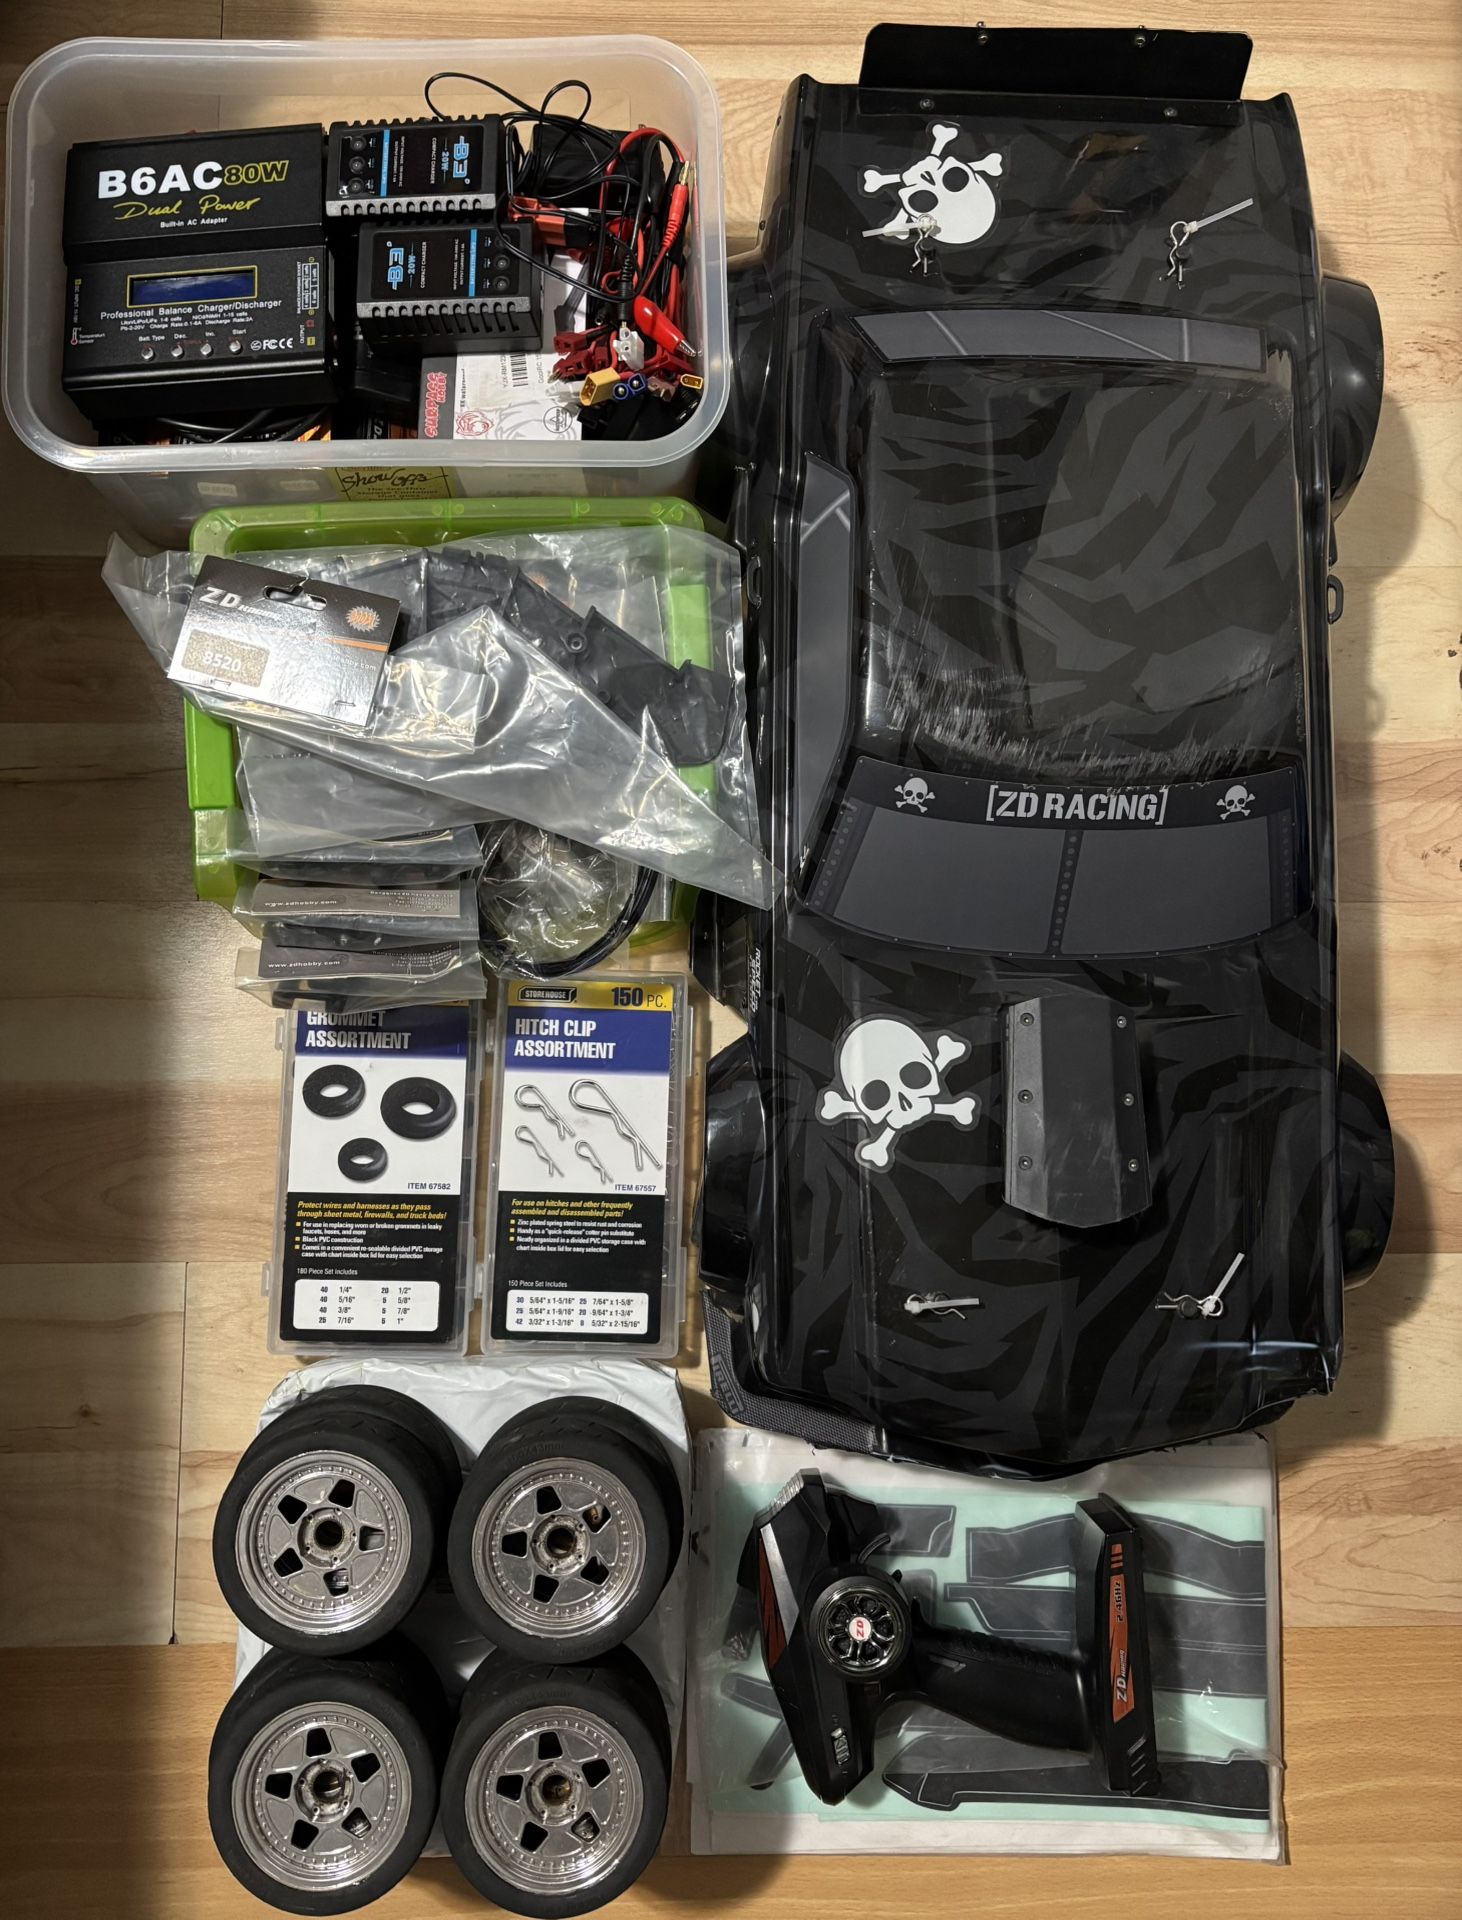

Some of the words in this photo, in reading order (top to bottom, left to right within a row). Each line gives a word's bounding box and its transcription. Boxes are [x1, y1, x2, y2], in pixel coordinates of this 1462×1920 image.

[441, 151, 450, 171] 20W
[224, 160, 289, 186] 80W
[113, 200, 183, 220] Dual
[199, 195, 261, 215] Power
[160, 220, 184, 228] Built-in
[200, 216, 228, 226] Adapter
[408, 255, 416, 275] 20W
[101, 309, 154, 320] Professional
[159, 307, 192, 316] Balance
[198, 300, 282, 313] Charger/Discharger
[437, 372, 447, 403] HOBBY
[424, 372, 442, 437] SURPASS
[200, 586, 242, 608] ZD
[203, 651, 241, 673] 8520
[525, 990, 567, 999] STOREHOUSE
[611, 986, 644, 1007] 150
[646, 994, 667, 1008] PC.
[307, 1010, 386, 1027] GROMMET
[515, 1018, 559, 1036] HITCH
[564, 1019, 597, 1037] CLIP
[306, 1030, 411, 1049] ASSORTMENT
[514, 1039, 616, 1060] ASSORTMENT
[297, 1210, 322, 1218] through
[323, 1210, 342, 1218] sheet
[357, 1202, 390, 1210] harnesses
[400, 1202, 415, 1211] they
[415, 1204, 432, 1212] pass
[600, 1201, 633, 1210] frequently
[604, 1210, 624, 1218] parts!
[427, 1223, 442, 1231] leaky
[614, 1320, 640, 1328] 2-15/16"
[1114, 1581, 1124, 1622] 2.4GHz
[856, 1619, 865, 1638] ZD
[1116, 1677, 1128, 1702] ZD
